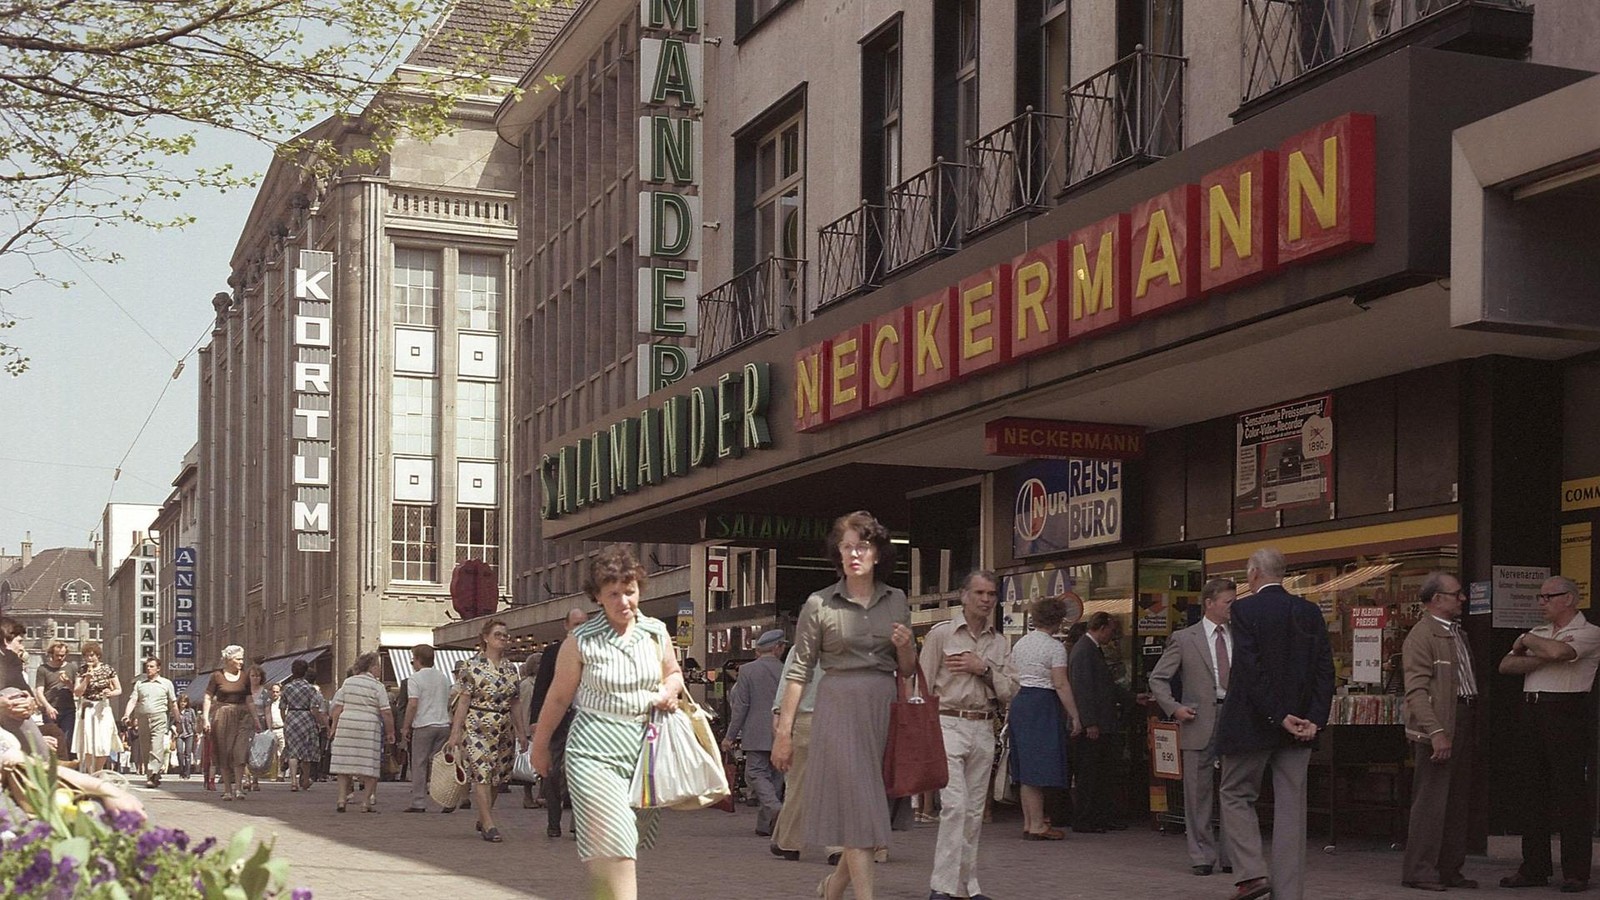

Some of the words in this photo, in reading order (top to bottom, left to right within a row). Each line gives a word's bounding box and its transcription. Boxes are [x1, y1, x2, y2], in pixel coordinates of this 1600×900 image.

[796, 136, 1339, 419] NECKERMANN
[294, 267, 330, 533] KORTUM
[540, 363, 773, 520] SALAMANDER
[1004, 427, 1140, 453] NECKERMANN
[1070, 460, 1119, 497] REISE
[717, 513, 829, 538] SALAMAN
[1033, 490, 1068, 519] NUR
[1070, 497, 1118, 541] BÜRO
[177, 551, 194, 655] ANDRE
